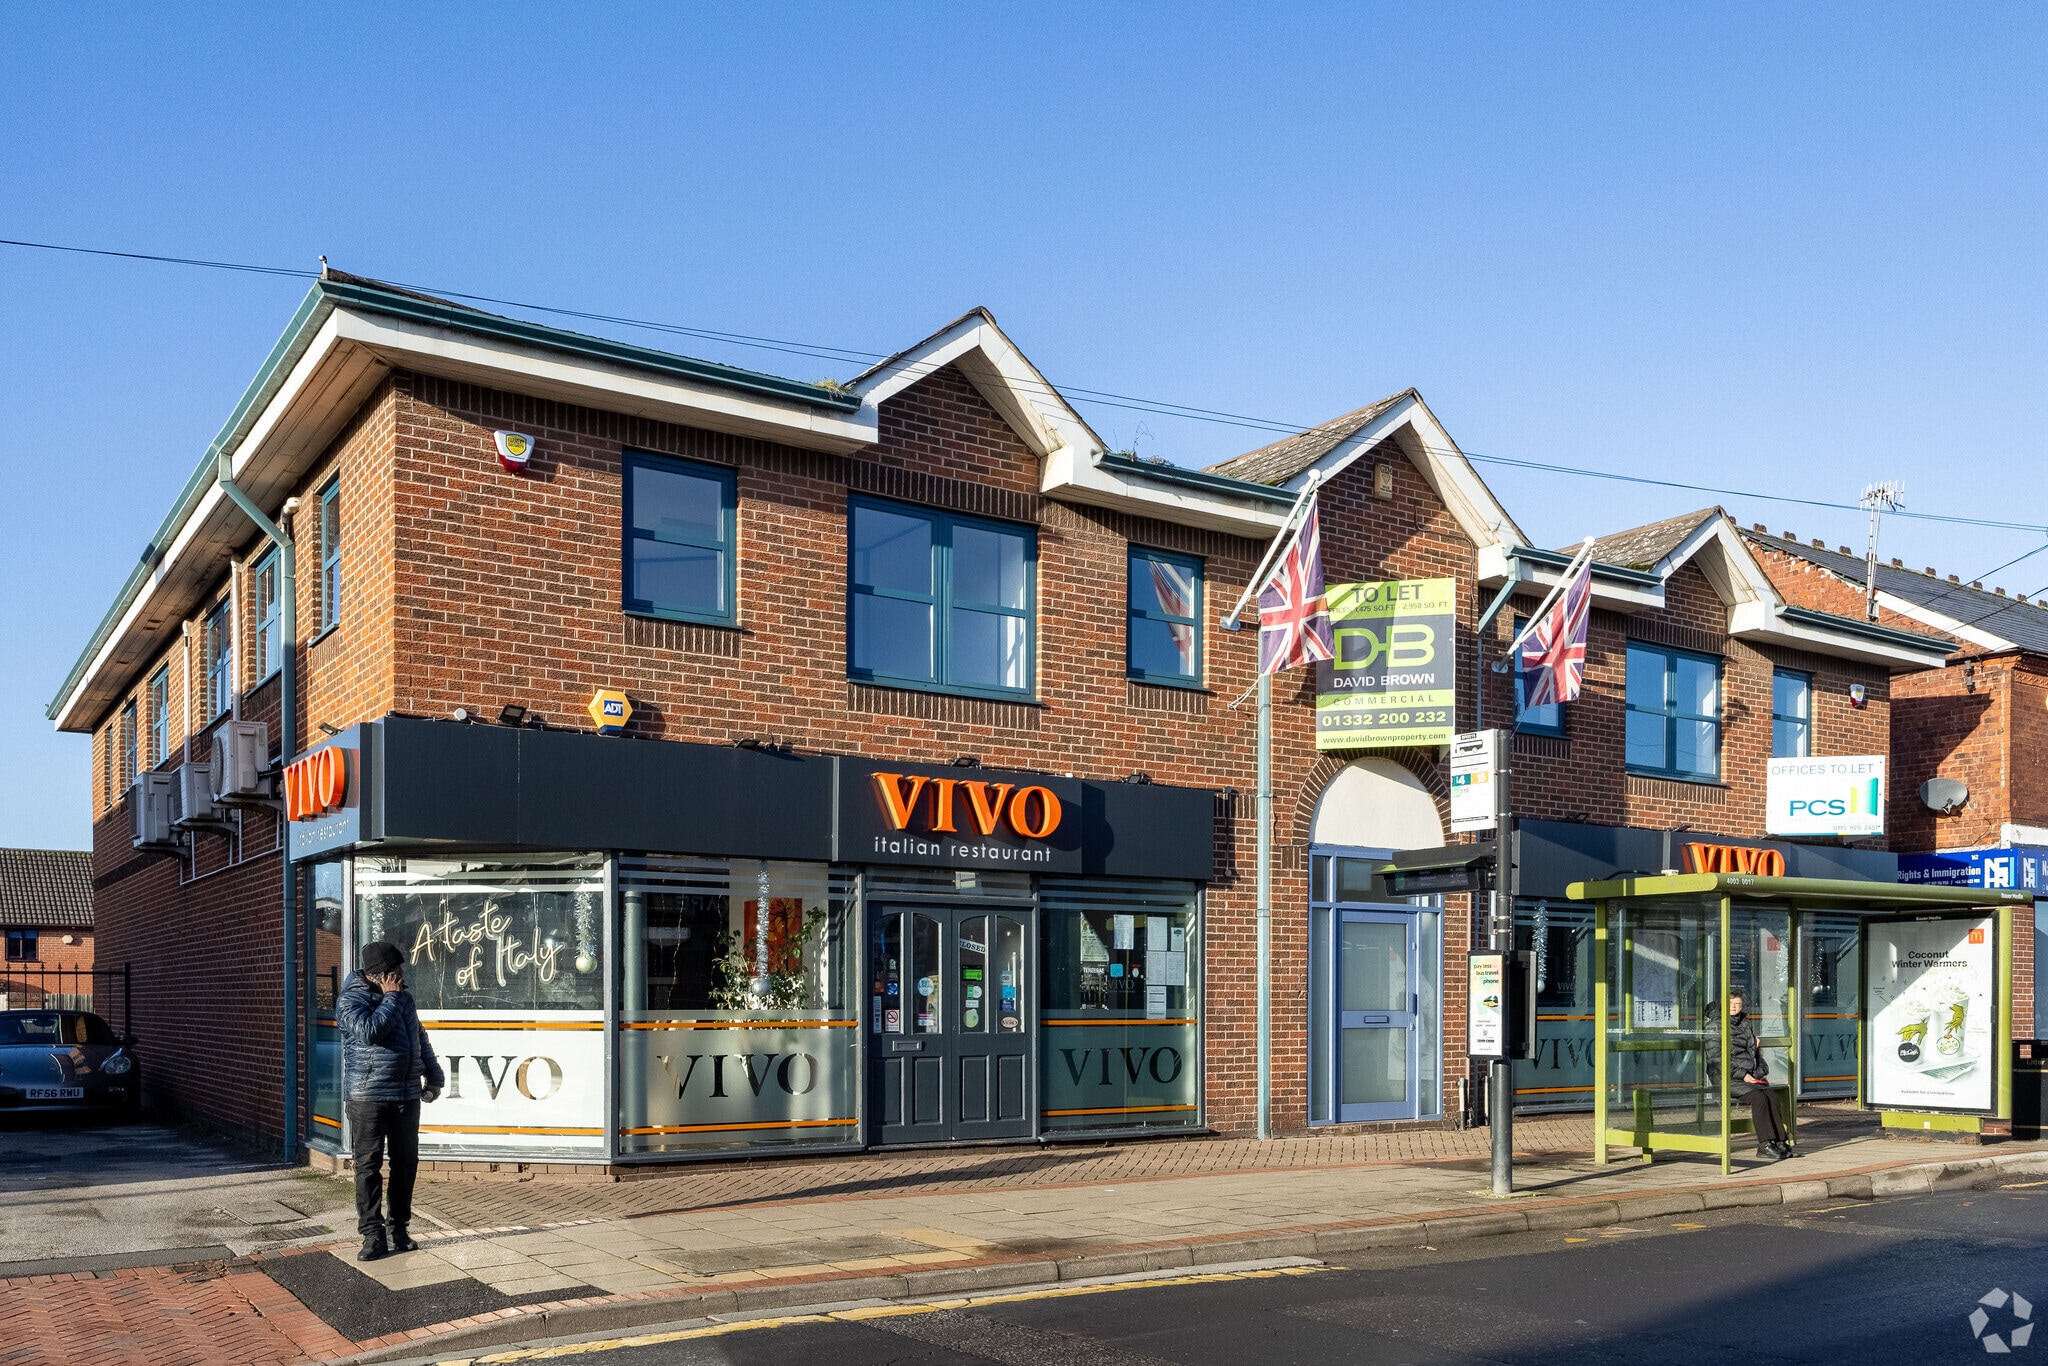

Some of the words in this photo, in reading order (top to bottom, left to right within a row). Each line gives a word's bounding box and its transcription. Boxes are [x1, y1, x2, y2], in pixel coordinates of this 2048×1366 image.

[1351, 586, 1379, 603] TO
[1386, 584, 1424, 602] LET
[1333, 676, 1376, 689] DAVID
[1380, 672, 1435, 686] BROWN
[603, 702, 623, 714] ADT
[1333, 694, 1435, 707] COMMERCIAL
[1321, 714, 1373, 728] 01332
[1378, 712, 1410, 725] 200
[1414, 710, 1447, 723] 232
[1322, 733, 1446, 744] www.davidbrownproperty.com
[1771, 764, 1826, 775] OFFICES
[1830, 763, 1847, 773] TO
[1850, 763, 1874, 773] LET
[282, 745, 345, 821] VIVO
[871, 771, 1063, 839] VIVO
[1789, 799, 1846, 816] PCS
[874, 836, 941, 857] italian
[950, 844, 1051, 863] restaurant
[1687, 842, 1785, 877] VIVO
[1726, 877, 1740, 885] 4003
[1897, 870, 1922, 882] Rights
[1923, 868, 1930, 879] &
[1931, 865, 1981, 879] Immigration
[410, 922, 436, 965] A
[432, 901, 513, 952] taste
[455, 944, 483, 991] of
[496, 926, 565, 987] Italy
[1891, 960, 1922, 968] Winter
[1924, 959, 1968, 968] Warmers
[1908, 951, 1949, 959] Coconut
[1059, 1046, 1182, 1087] VIVO
[435, 1055, 563, 1101] IVO
[656, 1053, 819, 1099] VIVO
[30, 1088, 57, 1098] RF56
[60, 1088, 80, 1097] RWU
